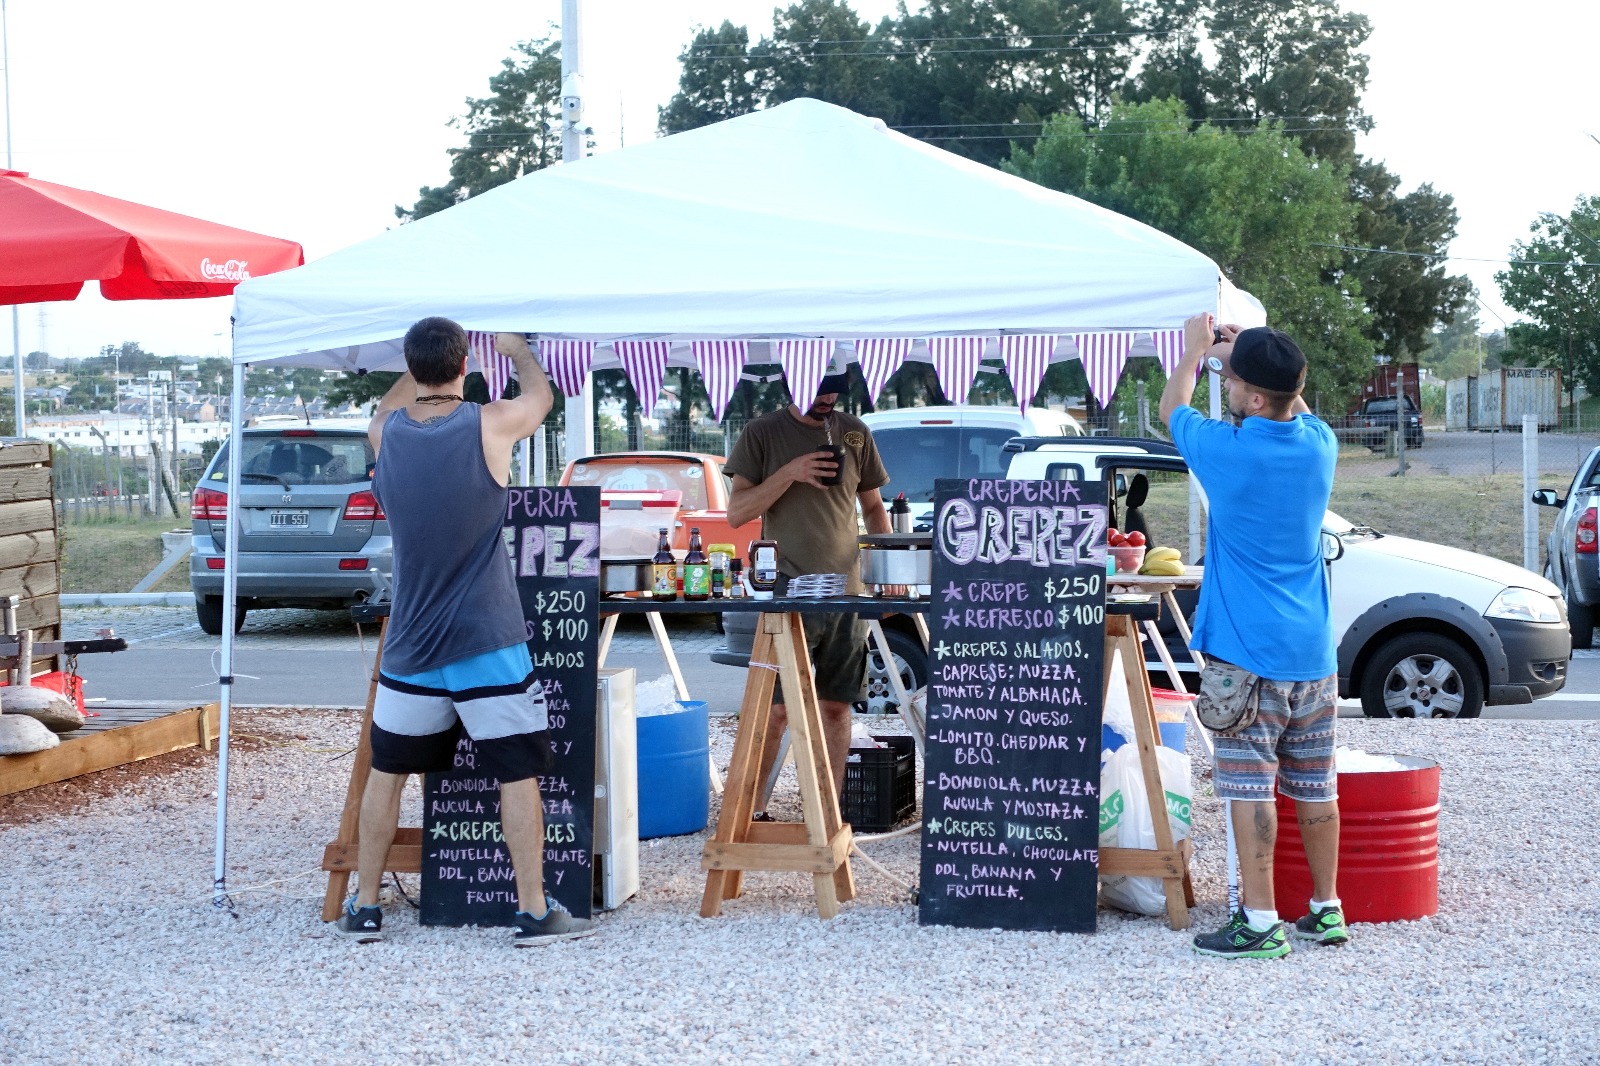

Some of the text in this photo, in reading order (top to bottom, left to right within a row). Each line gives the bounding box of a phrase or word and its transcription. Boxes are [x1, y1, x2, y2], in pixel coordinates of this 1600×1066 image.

[1507, 369, 1555, 379] MAESK
[968, 478, 1081, 504] CREPERIA
[507, 488, 578, 520] PERIA
[291, 514, 308, 525] 551
[968, 574, 1101, 604] CREPE $250
[534, 590, 586, 616] $250
[964, 604, 1104, 630] REFRESCO $100
[542, 618, 588, 642] $100
[953, 640, 1089, 660] CREPES SALADOS.
[533, 651, 585, 669] LADOS
[933, 685, 985, 699] TOMATE
[987, 686, 996, 700] Y
[1004, 709, 1015, 724] Y
[1019, 709, 1073, 727] QUESO.
[563, 741, 573, 755] Y
[1001, 733, 1069, 751] CHEDDAR
[1077, 736, 1087, 752] Y
[954, 747, 1001, 765] BBQ.
[431, 799, 485, 816] RUCULA
[943, 795, 995, 811] RUCULA
[1003, 800, 1012, 815] Y
[449, 822, 576, 843] CREPE CES
[944, 816, 1068, 842] CREPES DULCES.
[554, 870, 565, 885] Y
[971, 864, 1036, 880] BANANA
[1050, 867, 1062, 882] Y
[466, 891, 519, 904] FRUTIL
[946, 884, 1024, 901] FRUTILLA.
